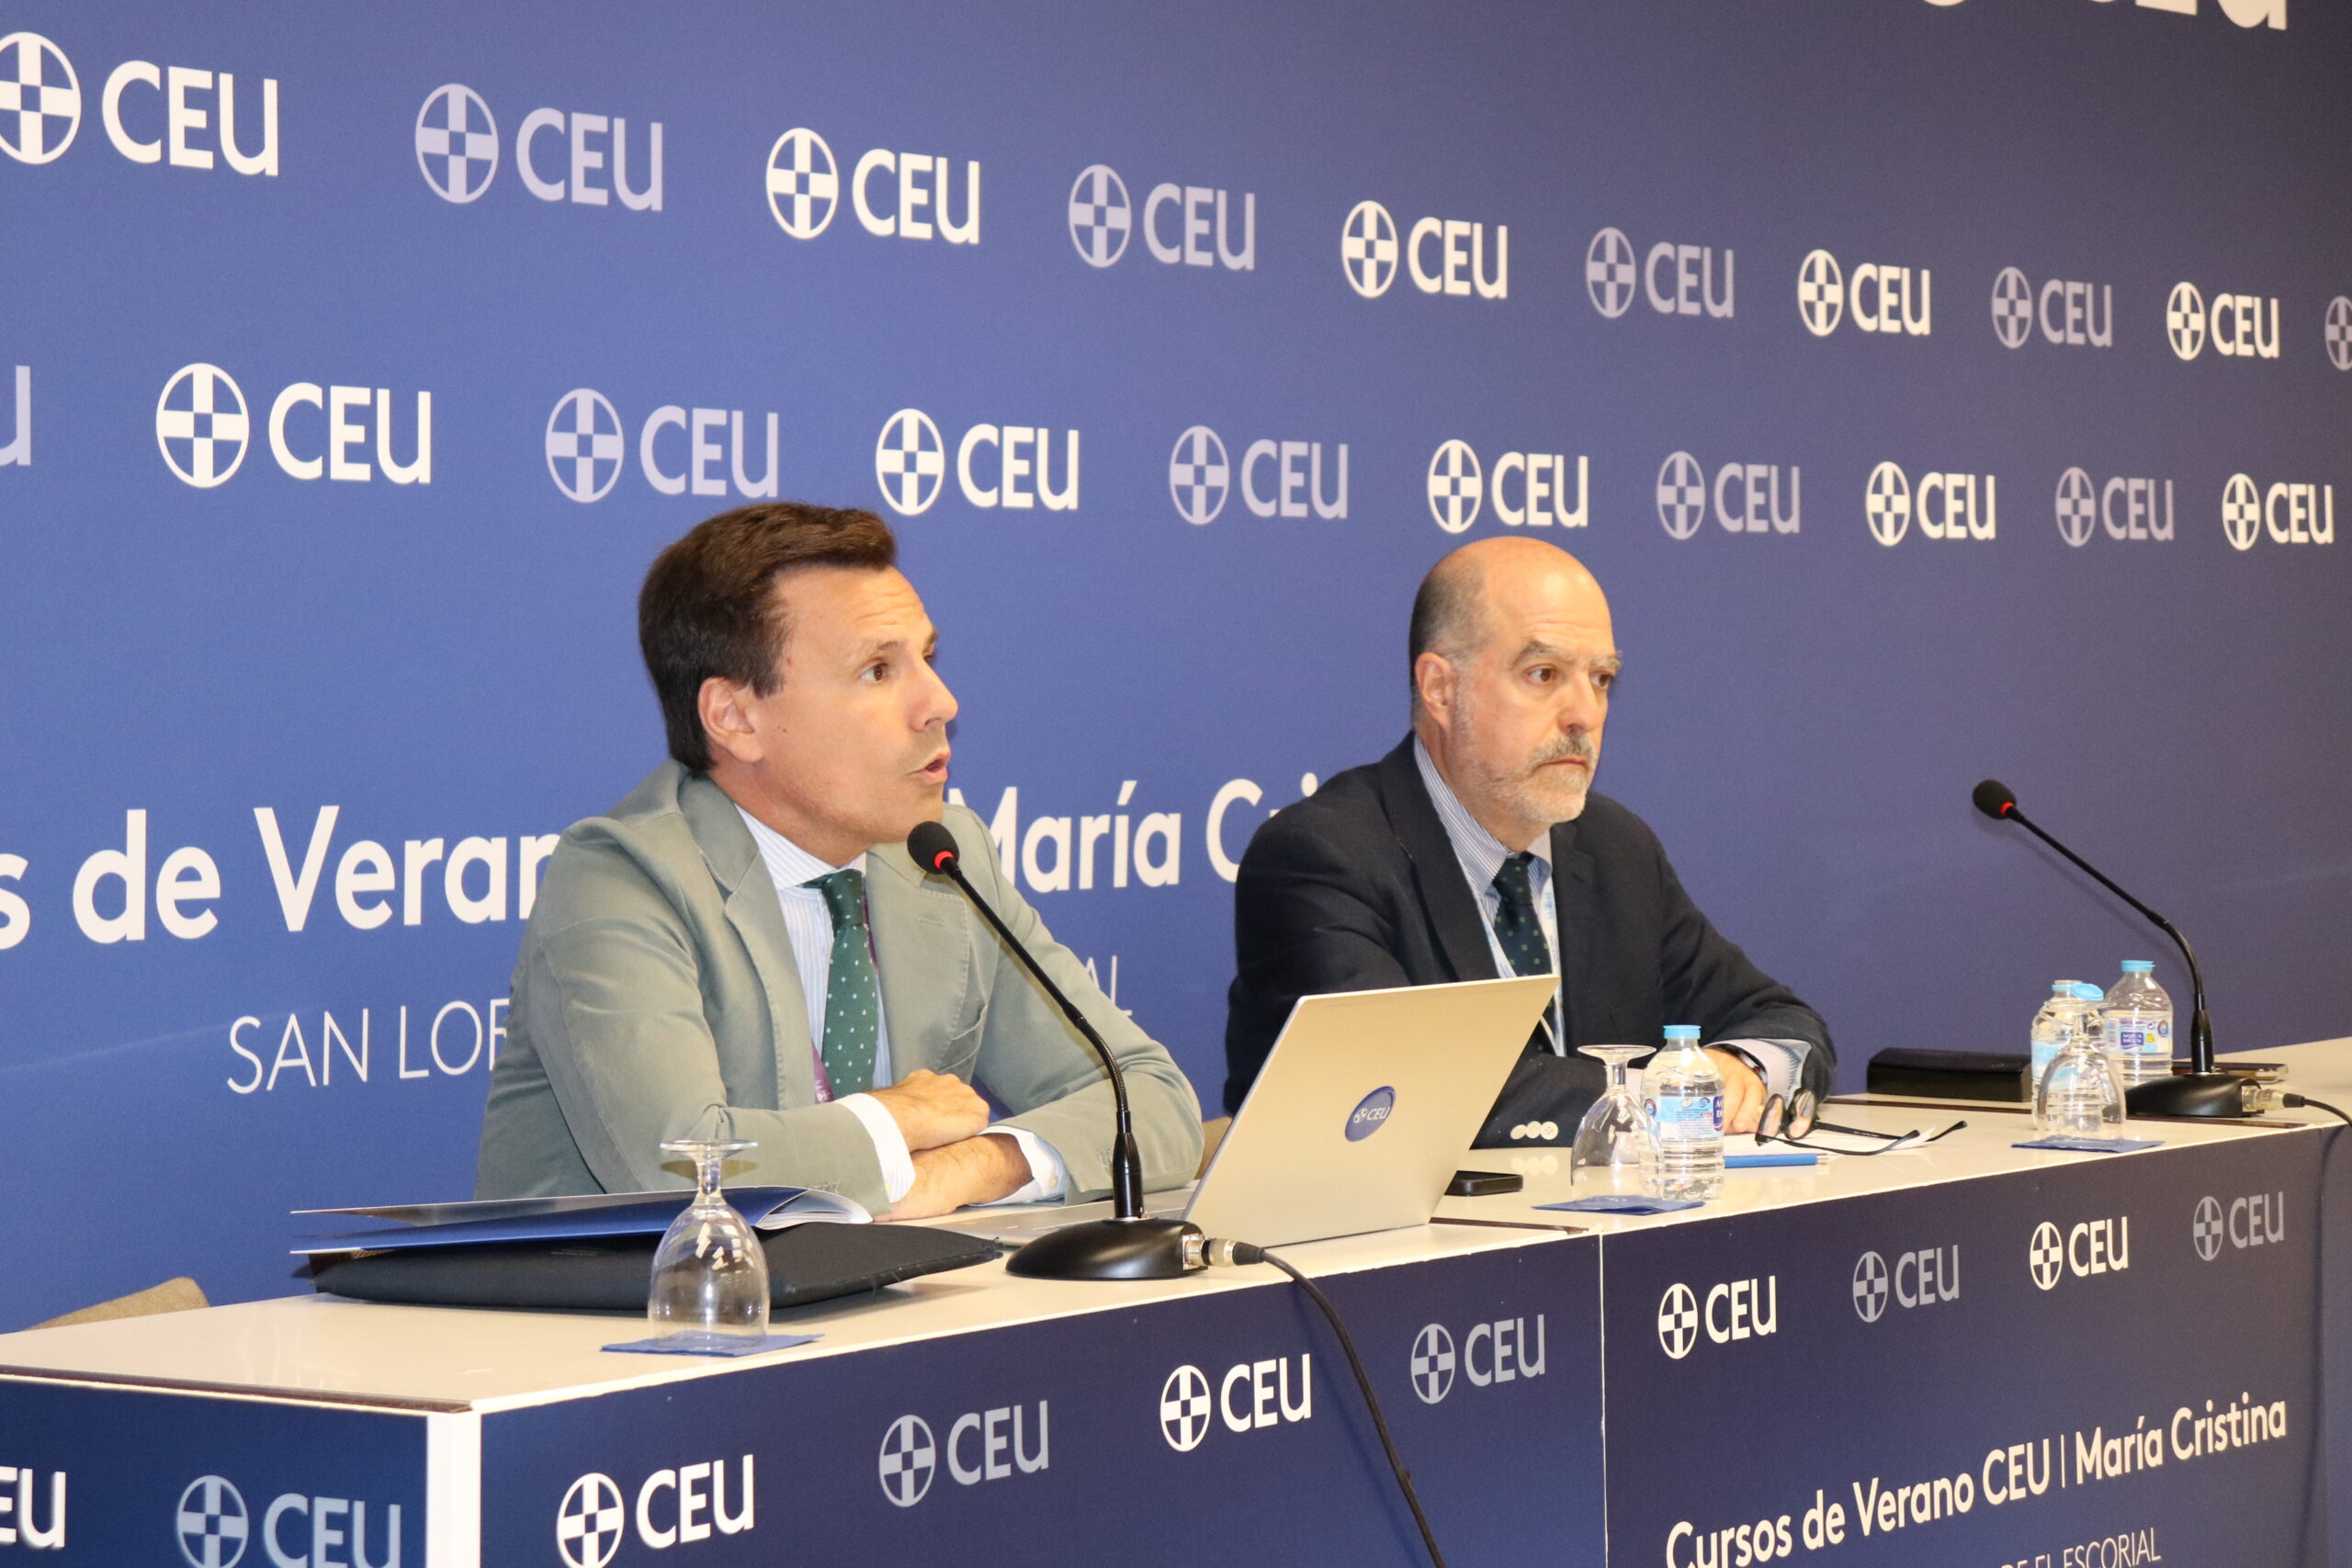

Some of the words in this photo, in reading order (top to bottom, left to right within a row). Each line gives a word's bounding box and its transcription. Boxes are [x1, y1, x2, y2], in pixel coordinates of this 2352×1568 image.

[102, 61, 278, 175] CEU
[516, 108, 662, 211] CEU
[853, 149, 979, 244] CEU
[1144, 184, 1254, 270] CEU
[1408, 218, 1507, 299] CEU
[1645, 243, 1734, 318] CEU
[1850, 264, 1930, 335] CEU
[2040, 279, 2111, 346] CEU
[2211, 294, 2278, 358] CEU
[269, 383, 431, 484] CEU
[640, 406, 778, 498] CEU
[958, 424, 1079, 510] CEU
[1241, 440, 1348, 519] CEU
[1492, 452, 1588, 527] CEU
[1714, 463, 1799, 534] CEU
[1917, 472, 1996, 539] CEU
[2102, 478, 2173, 540] CEU
[2266, 483, 2333, 544] CEU
[74, 809, 220, 943] de
[254, 806, 560, 931] Veran
[228, 1009, 368, 1093] SAN
[1367, 1106, 1390, 1121] CEU
[2069, 1216, 2128, 1277] CEU
[2230, 1192, 2283, 1248] CEU
[1705, 1276, 1776, 1343] CEU
[1895, 1245, 1959, 1308] CEU
[1465, 1314, 1544, 1386] CEU
[1221, 1354, 1311, 1432] CEU
[948, 1401, 1048, 1484] CEU
[1666, 1515, 1792, 1568] Cursos
[1803, 1490, 1845, 1550] de
[1852, 1472, 1974, 1537] Verano
[1982, 1438, 2051, 1506] CEU
[2076, 1416, 2163, 1483] María
[2171, 1392, 2286, 1460] Cristina
[0, 1466, 65, 1548] EU
[264, 1494, 401, 1568] CEU
[637, 1454, 753, 1549] CEU
